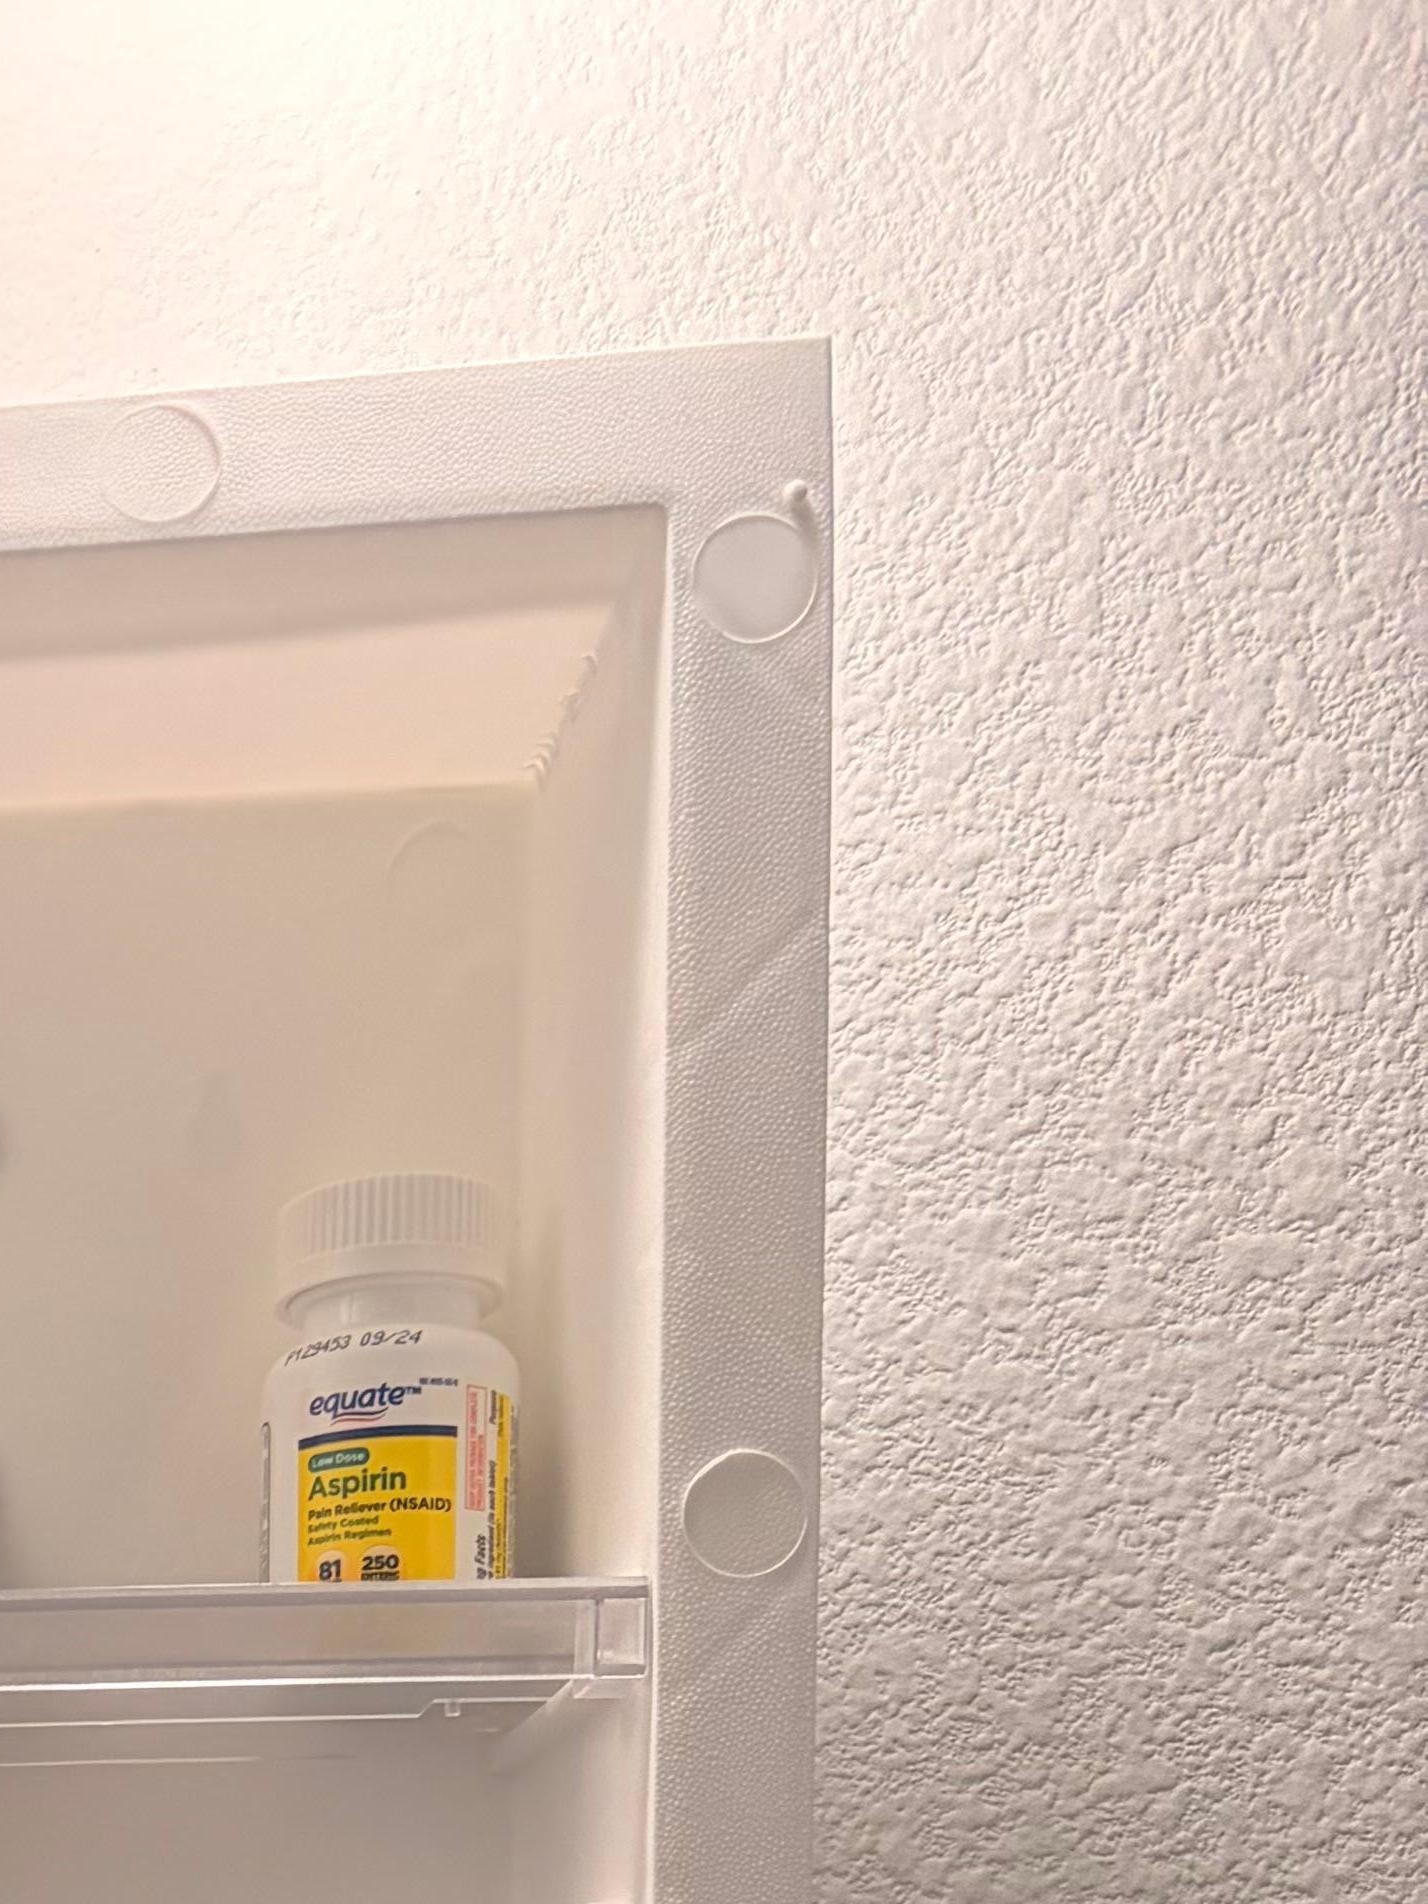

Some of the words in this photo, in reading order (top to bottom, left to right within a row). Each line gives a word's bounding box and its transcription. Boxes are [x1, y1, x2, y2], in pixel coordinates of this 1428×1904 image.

[359, 1329, 423, 1347] 09/24
[335, 1452, 365, 1464] Dose
[308, 1466, 407, 1500] Aspirin
[308, 1508, 332, 1521] Pain
[334, 1501, 387, 1516] Reliever
[389, 1497, 451, 1512] (NSAID)
[339, 1515, 379, 1527] Coated
[307, 1533, 342, 1546] Aspirin
[344, 1528, 392, 1540] Regimen
[319, 1558, 342, 1581] 81
[361, 1554, 400, 1571] 250
